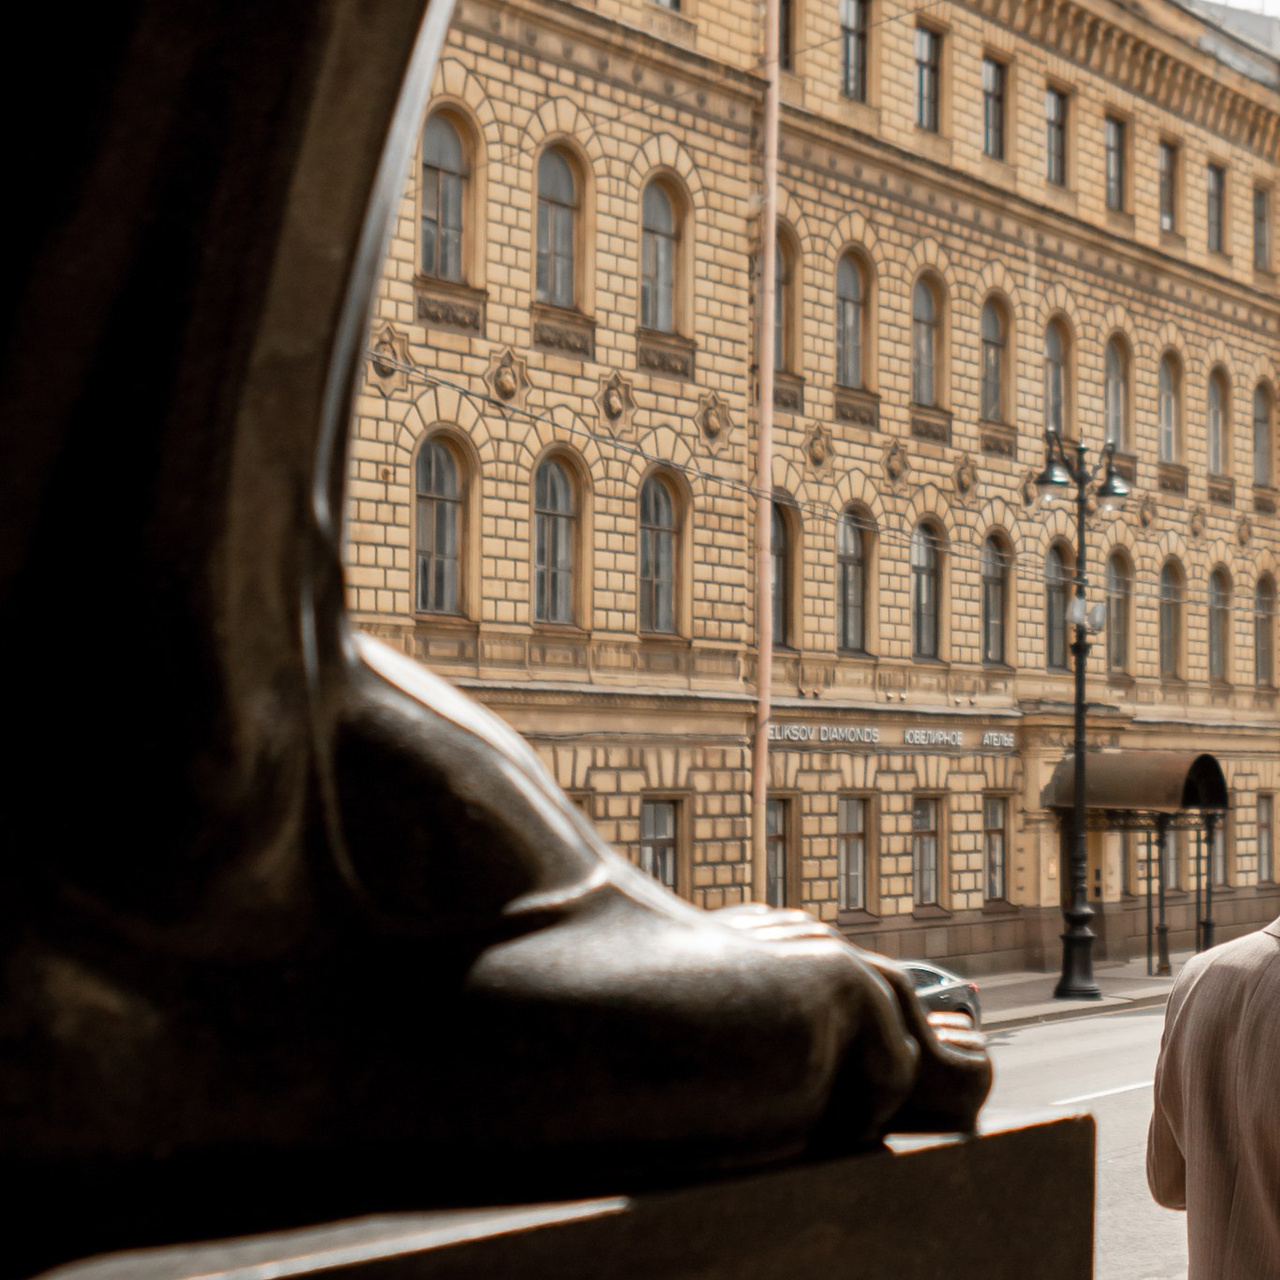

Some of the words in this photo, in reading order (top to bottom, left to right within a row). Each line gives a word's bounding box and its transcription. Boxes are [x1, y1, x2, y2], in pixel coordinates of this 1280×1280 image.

[767, 725, 814, 741] ELIKSOV
[819, 726, 880, 743] DIAMONDS
[903, 730, 963, 746] ЮВЕЛИРНОЕ
[982, 732, 1015, 747] АТЕЛЬЕ
